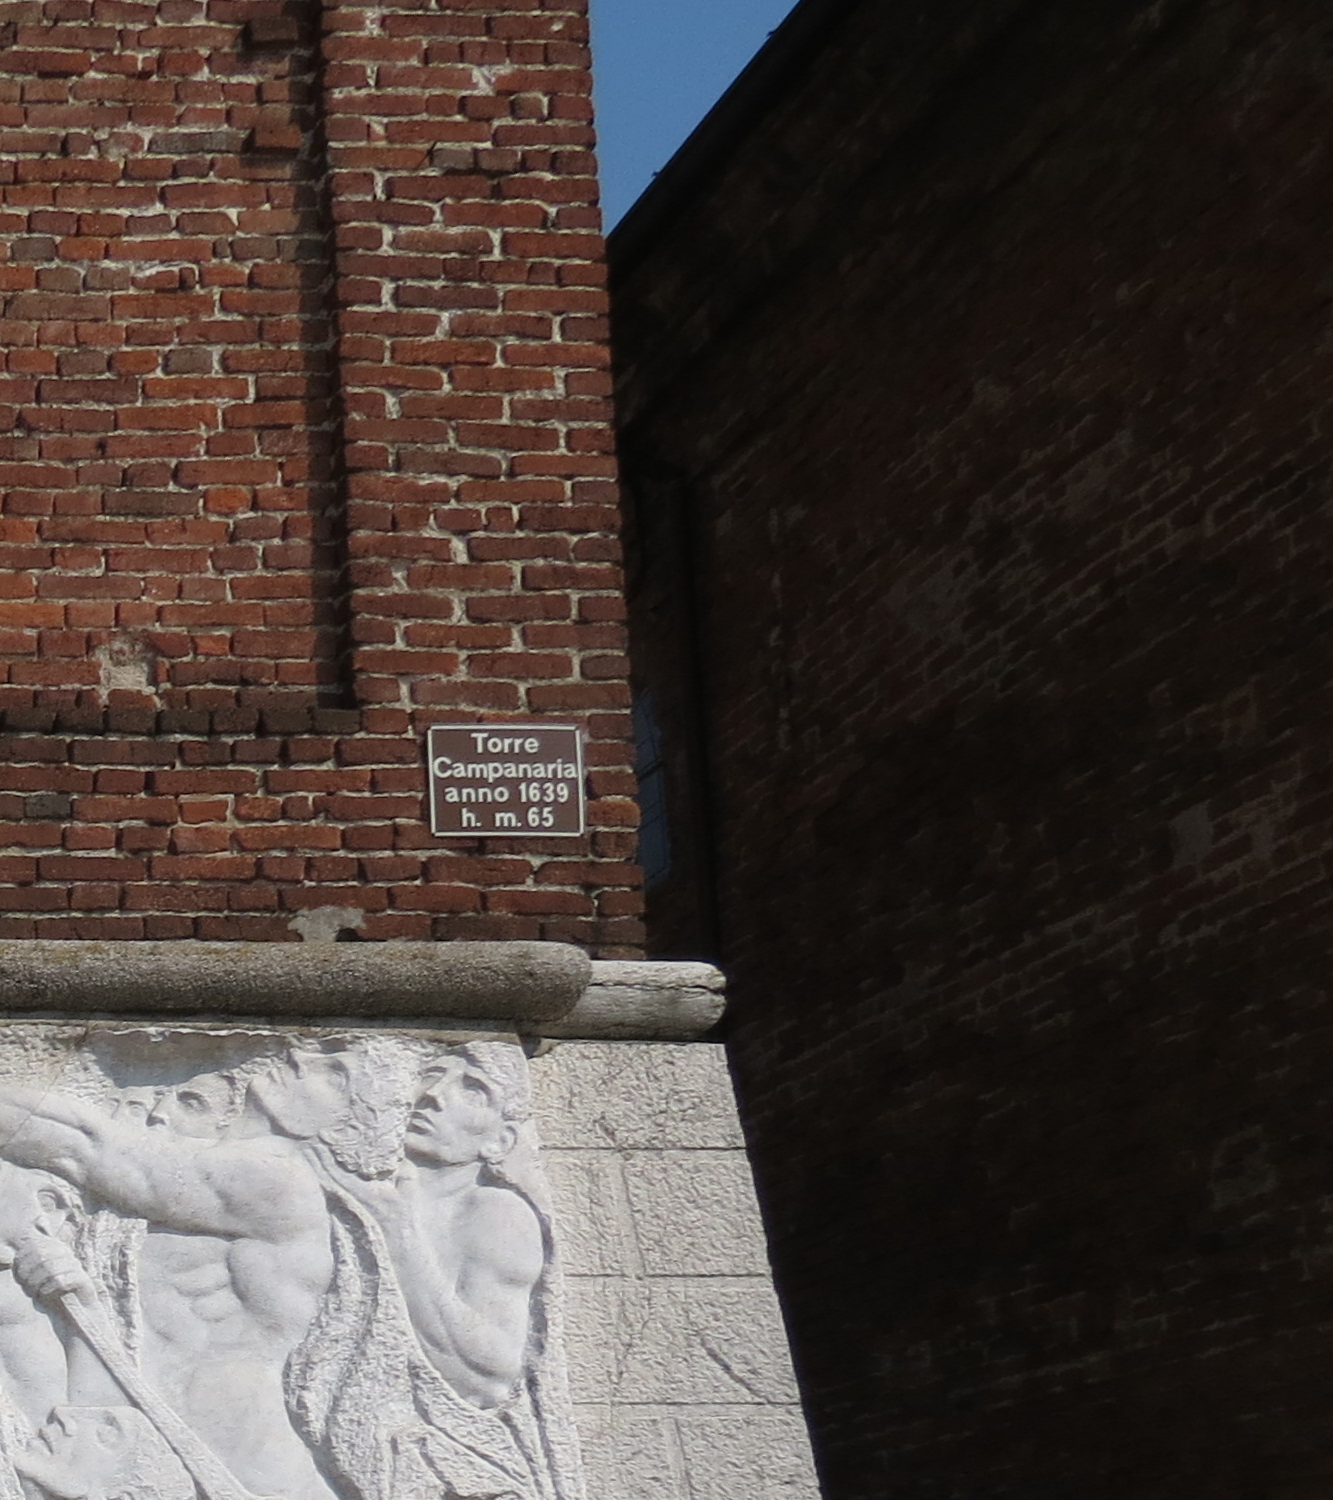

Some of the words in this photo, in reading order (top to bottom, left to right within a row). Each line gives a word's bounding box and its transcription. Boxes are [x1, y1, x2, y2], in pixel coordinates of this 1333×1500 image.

[471, 733, 540, 754] Torre
[433, 757, 577, 782] Campanaria
[444, 787, 509, 803] anno
[518, 782, 568, 803] 1639
[461, 808, 481, 827] h.
[495, 812, 521, 827] m.
[527, 807, 554, 827] 65
